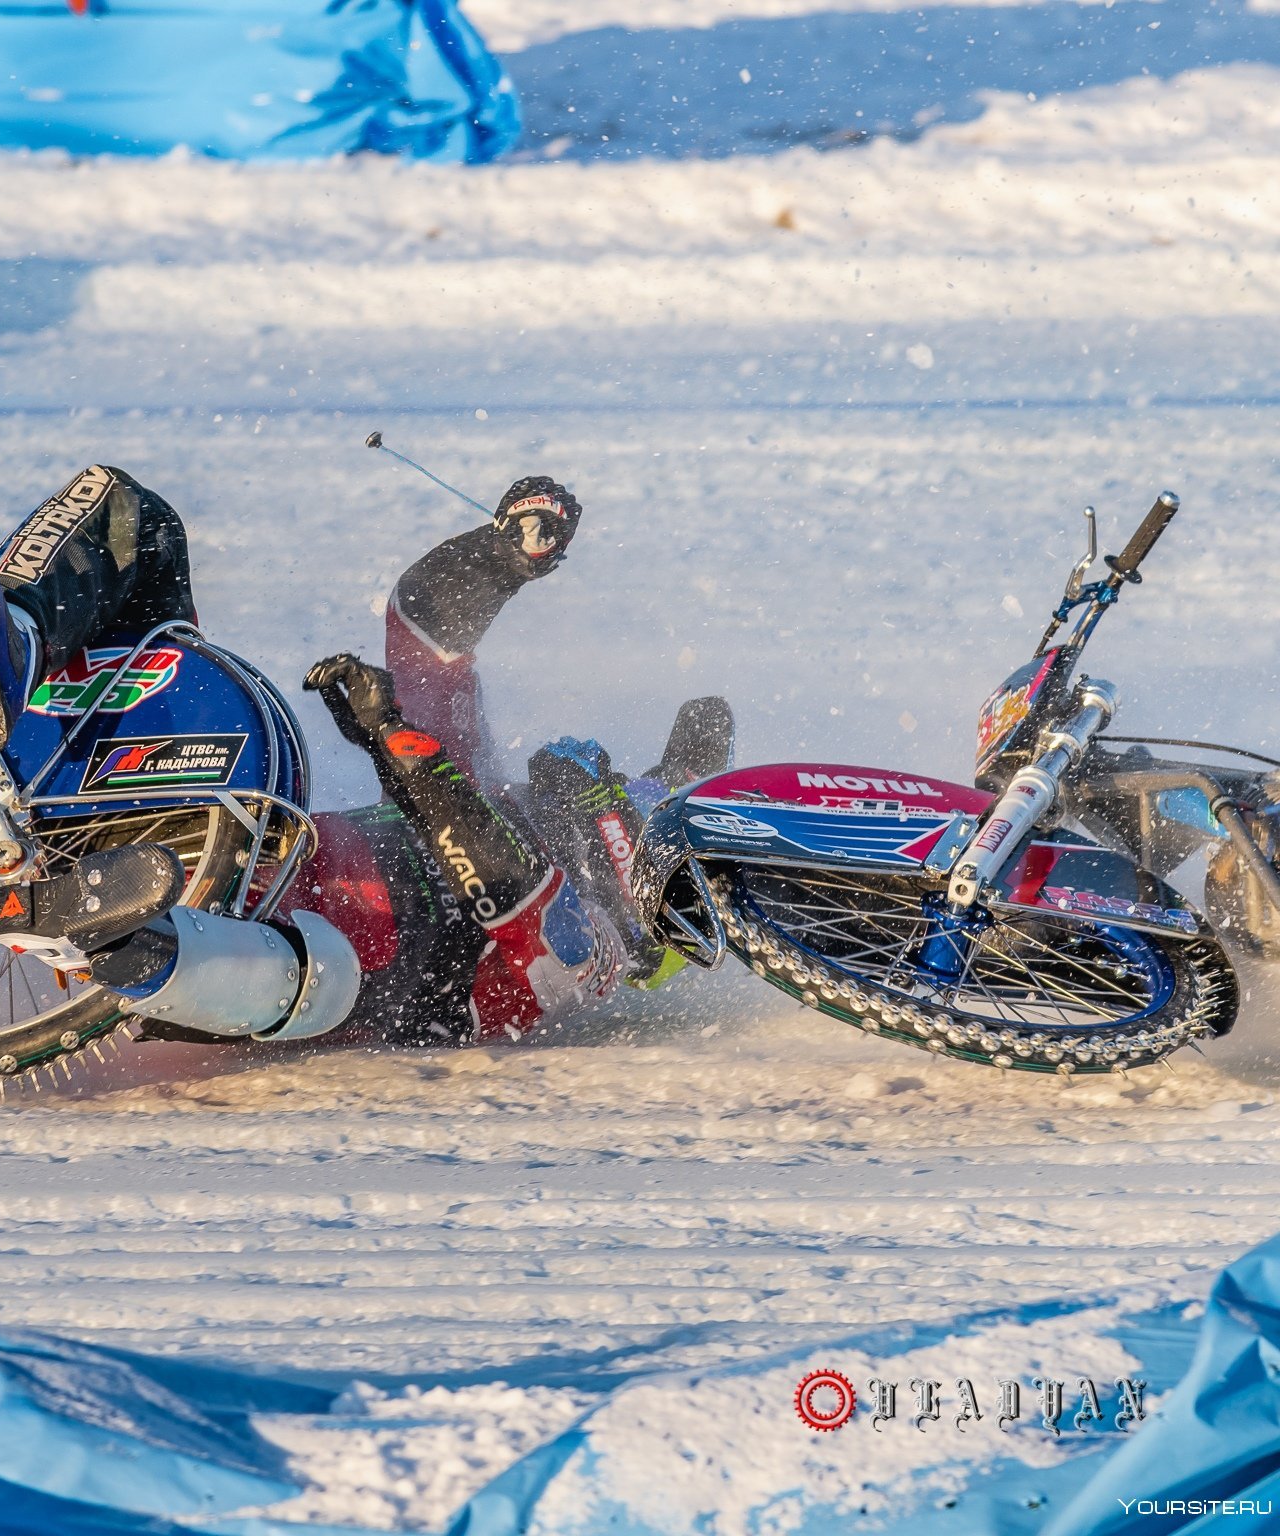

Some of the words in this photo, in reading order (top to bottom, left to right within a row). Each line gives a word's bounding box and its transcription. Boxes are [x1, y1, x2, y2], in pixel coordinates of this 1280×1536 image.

[6, 464, 110, 579] KOLTAKOV
[156, 757, 226, 771] КАДЫРОВА
[180, 744, 215, 757] ЦТВС
[797, 772, 944, 798] MOTUL
[979, 820, 1010, 850] MOTUL
[438, 824, 499, 919] WACO
